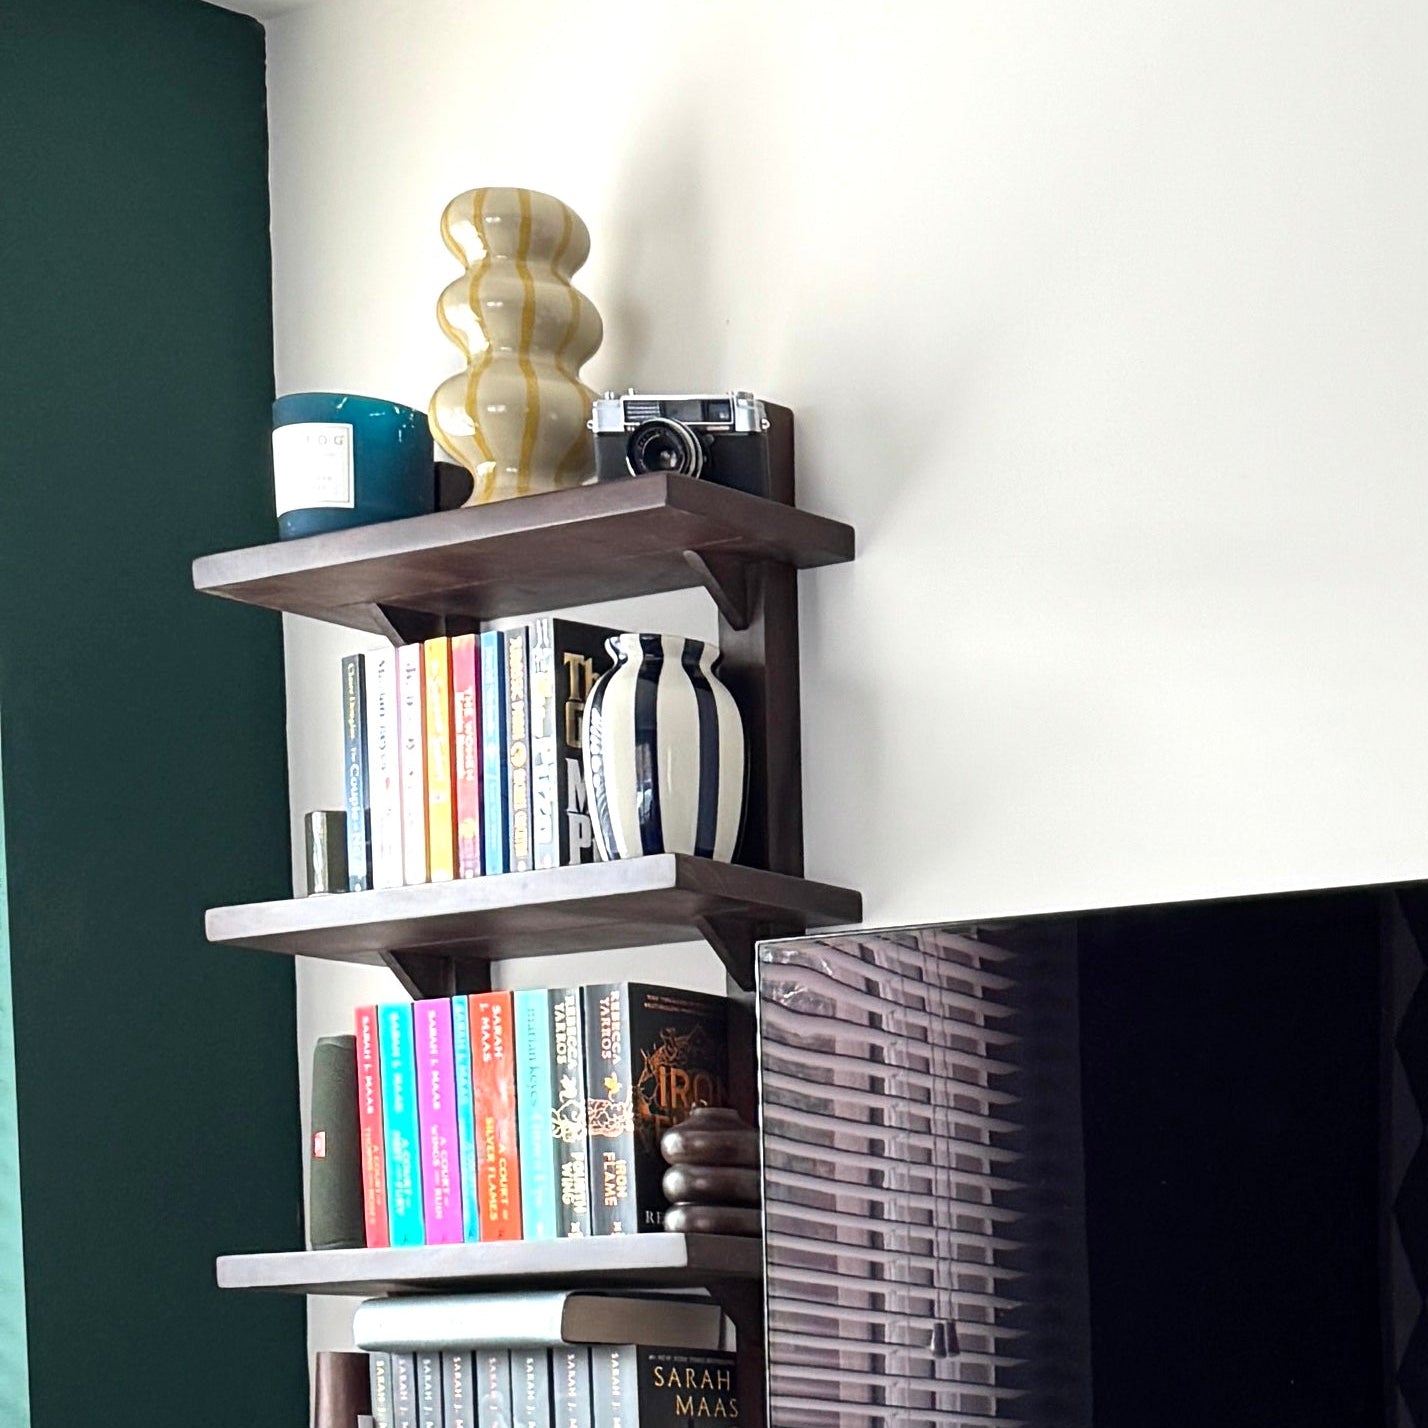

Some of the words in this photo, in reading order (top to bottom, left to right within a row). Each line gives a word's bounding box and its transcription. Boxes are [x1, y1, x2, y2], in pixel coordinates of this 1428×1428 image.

[463, 686, 474, 716] THE
[464, 720, 476, 782] WOMEN
[362, 1015, 372, 1060] SARAH
[428, 1009, 439, 1055] SARAH
[481, 1017, 492, 1062] MAAS
[492, 1004, 504, 1058] SARAH
[554, 1001, 568, 1064] YARROS
[564, 995, 578, 1070] REBECCA
[600, 997, 612, 1060] YARROS
[610, 990, 622, 1066] REBECCA
[365, 1074, 374, 1114] MAAS
[432, 1070, 441, 1110] MAAS
[486, 1116, 497, 1162] SILVER
[498, 1143, 507, 1154] A
[441, 1149, 450, 1195] COURT
[487, 1166, 499, 1221] FLAMES
[499, 1158, 509, 1204] COURT
[561, 1161, 575, 1205] WING
[570, 1150, 587, 1215] FOURTH
[603, 1151, 618, 1206] FLAME
[615, 1160, 628, 1198] IRON
[376, 1359, 387, 1402] SARAH
[398, 1359, 408, 1401] SARAH
[423, 1358, 433, 1401] SARAH
[453, 1356, 463, 1398] SARAH
[525, 1357, 536, 1400] SARAH
[567, 1353, 578, 1397] SARAH
[610, 1352, 621, 1396] SARAH
[653, 1366, 731, 1391] SARAH
[676, 1394, 739, 1418] MAAS
